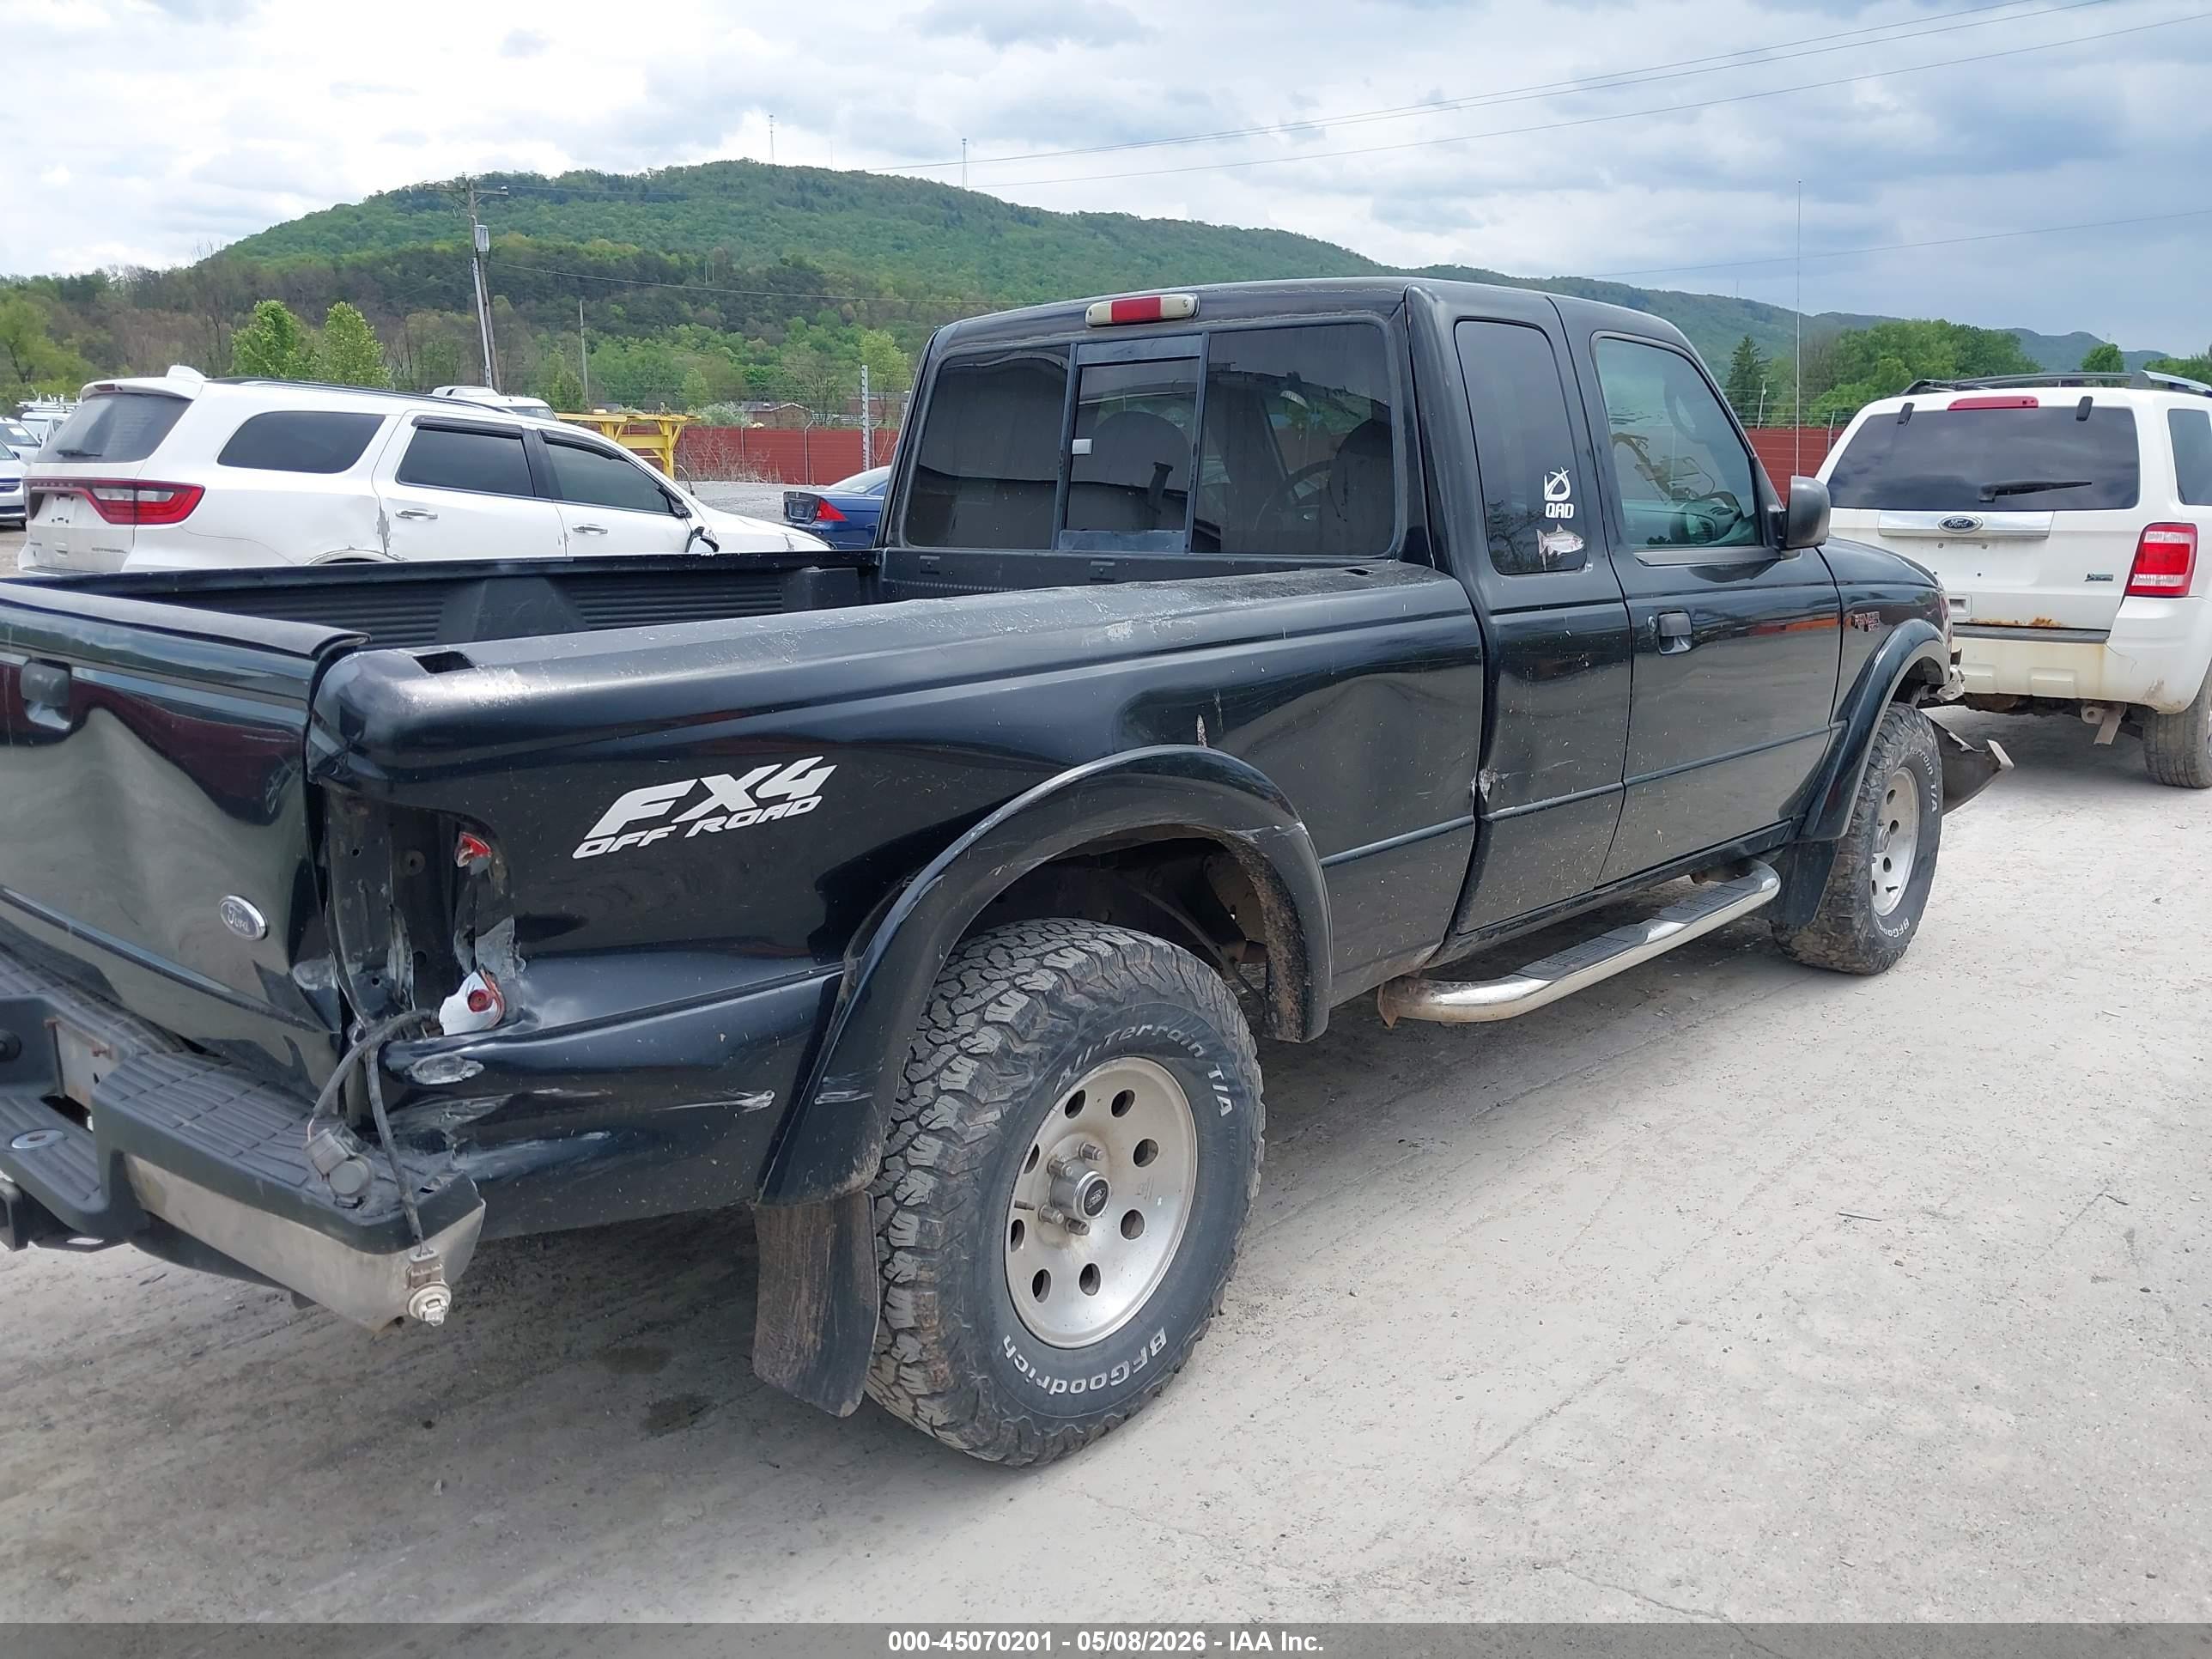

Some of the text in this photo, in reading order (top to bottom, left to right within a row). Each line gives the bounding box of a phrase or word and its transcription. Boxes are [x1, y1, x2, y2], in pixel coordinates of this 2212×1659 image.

[572, 795, 823, 860] OFF ROAD
[584, 756, 837, 840] FX4
[1207, 1063, 1233, 1117] T/A
[1003, 1327, 1168, 1395] BFGoodrich
